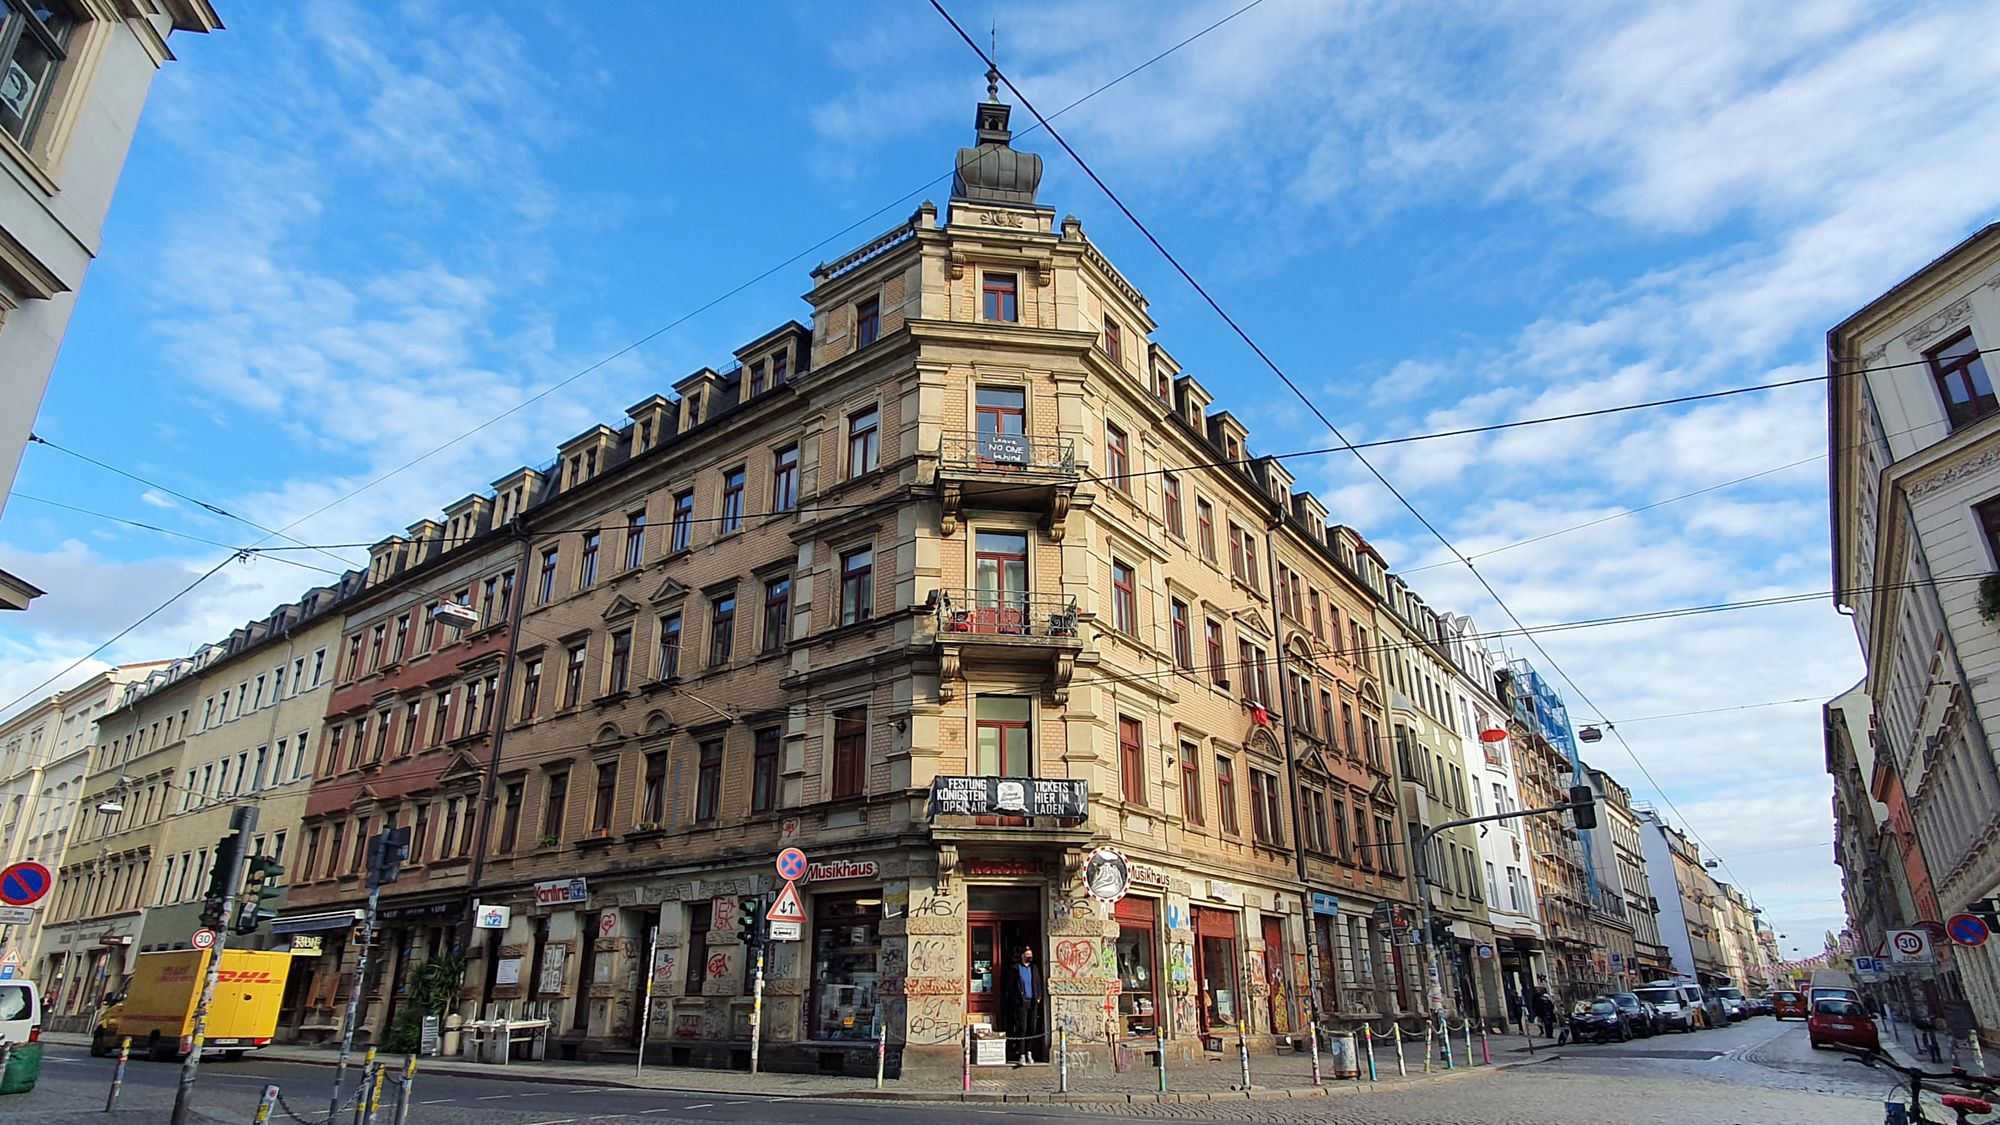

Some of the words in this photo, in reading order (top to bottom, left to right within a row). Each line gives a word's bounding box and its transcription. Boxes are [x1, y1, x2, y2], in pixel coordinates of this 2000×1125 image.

[992, 436, 1017, 444] Leave
[988, 443, 1003, 451] NO
[1005, 445, 1025, 454] ONE
[993, 452, 1021, 461] behind
[948, 778, 987, 790] FESTUNG
[1034, 781, 1069, 793] TICKETS
[936, 788, 987, 801] KÖNIGSTEIN
[1034, 792, 1056, 804] HIER
[1058, 793, 1070, 804] IM
[970, 801, 987, 813] AIR
[1034, 803, 1065, 815] LADEN
[804, 860, 875, 881] Musikhaus
[1130, 864, 1171, 886] Musikhaus
[485, 916, 502, 926] N2
[197, 934, 211, 945] 30
[1900, 937, 1917, 948] 30
[217, 970, 272, 984] DHL
